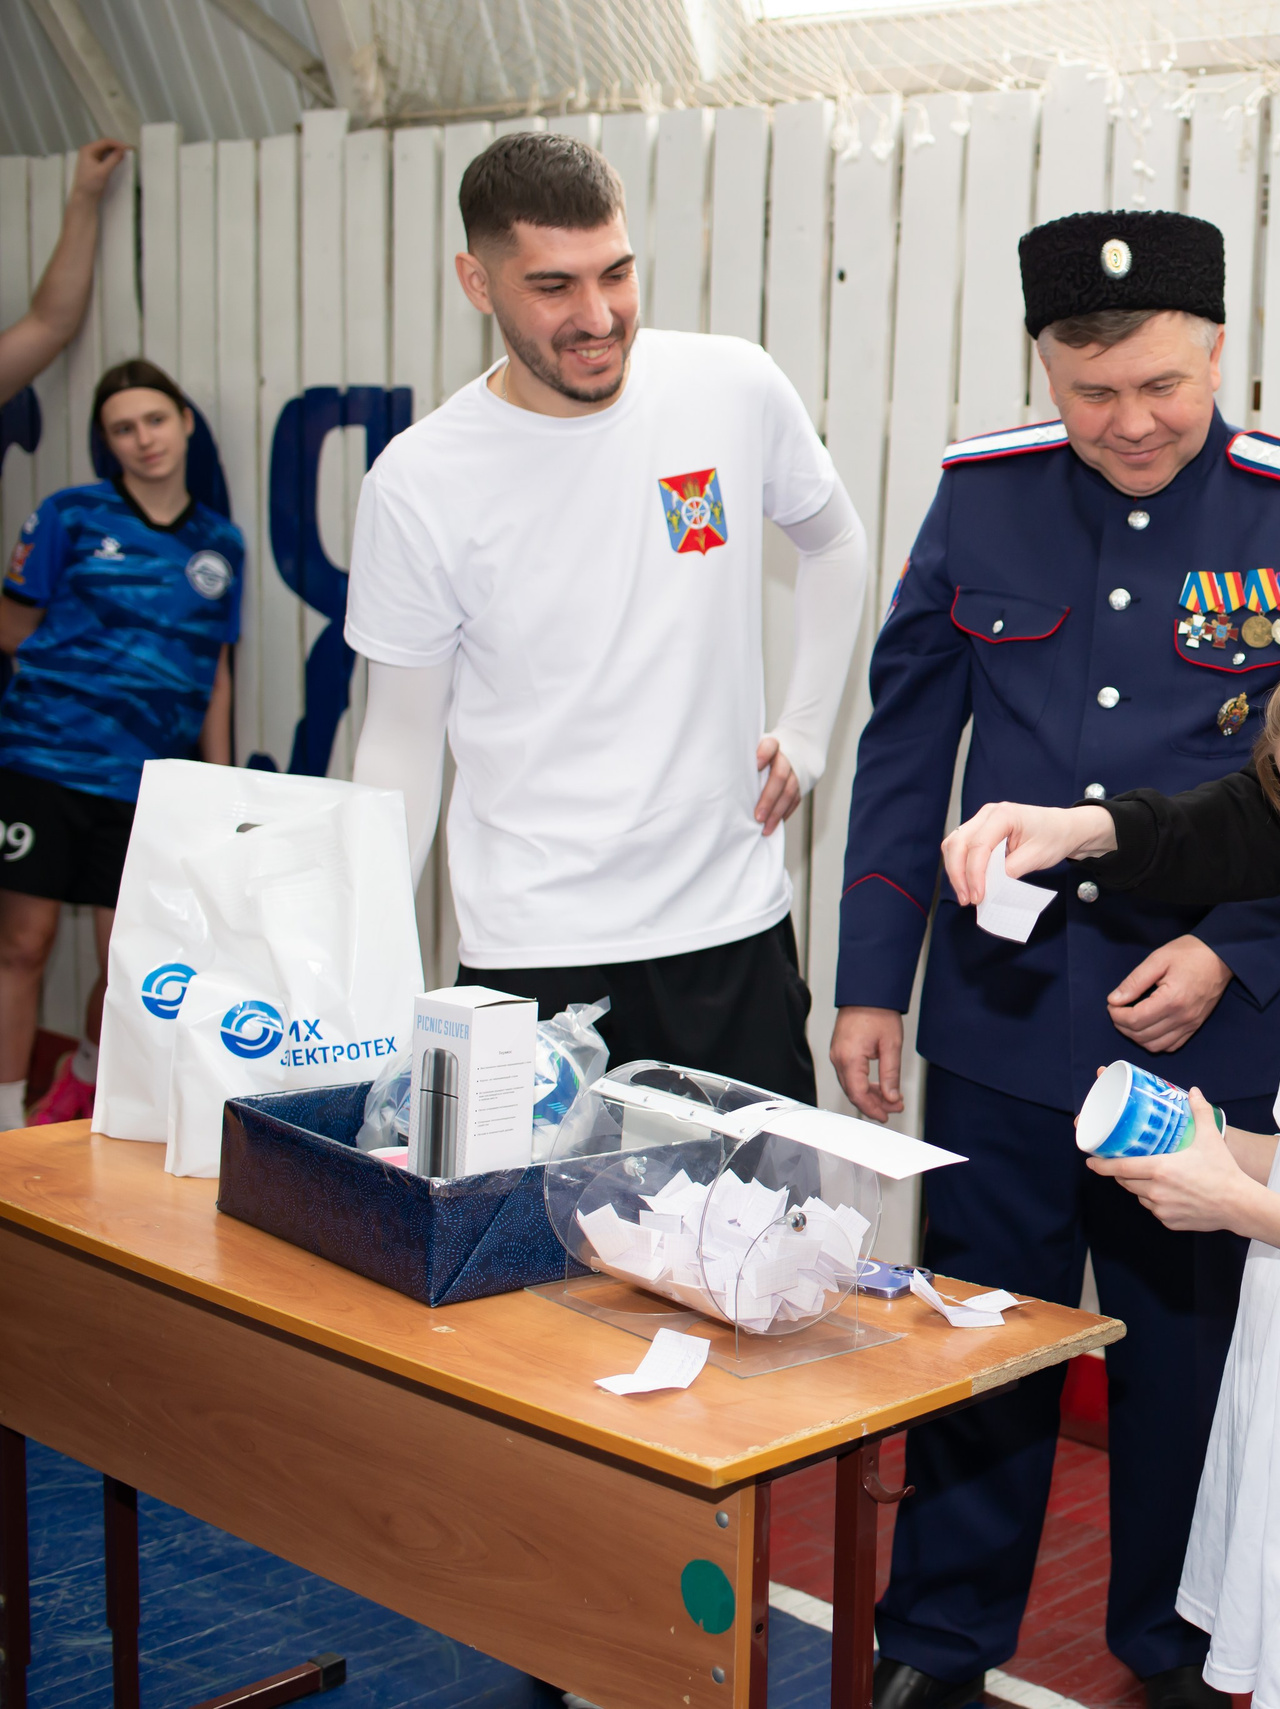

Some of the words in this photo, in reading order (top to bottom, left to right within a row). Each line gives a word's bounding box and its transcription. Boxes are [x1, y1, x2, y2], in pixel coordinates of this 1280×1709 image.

[0, 819, 36, 862] 9
[416, 1014, 443, 1035] PICNIC
[444, 1020, 470, 1040] SILVER
